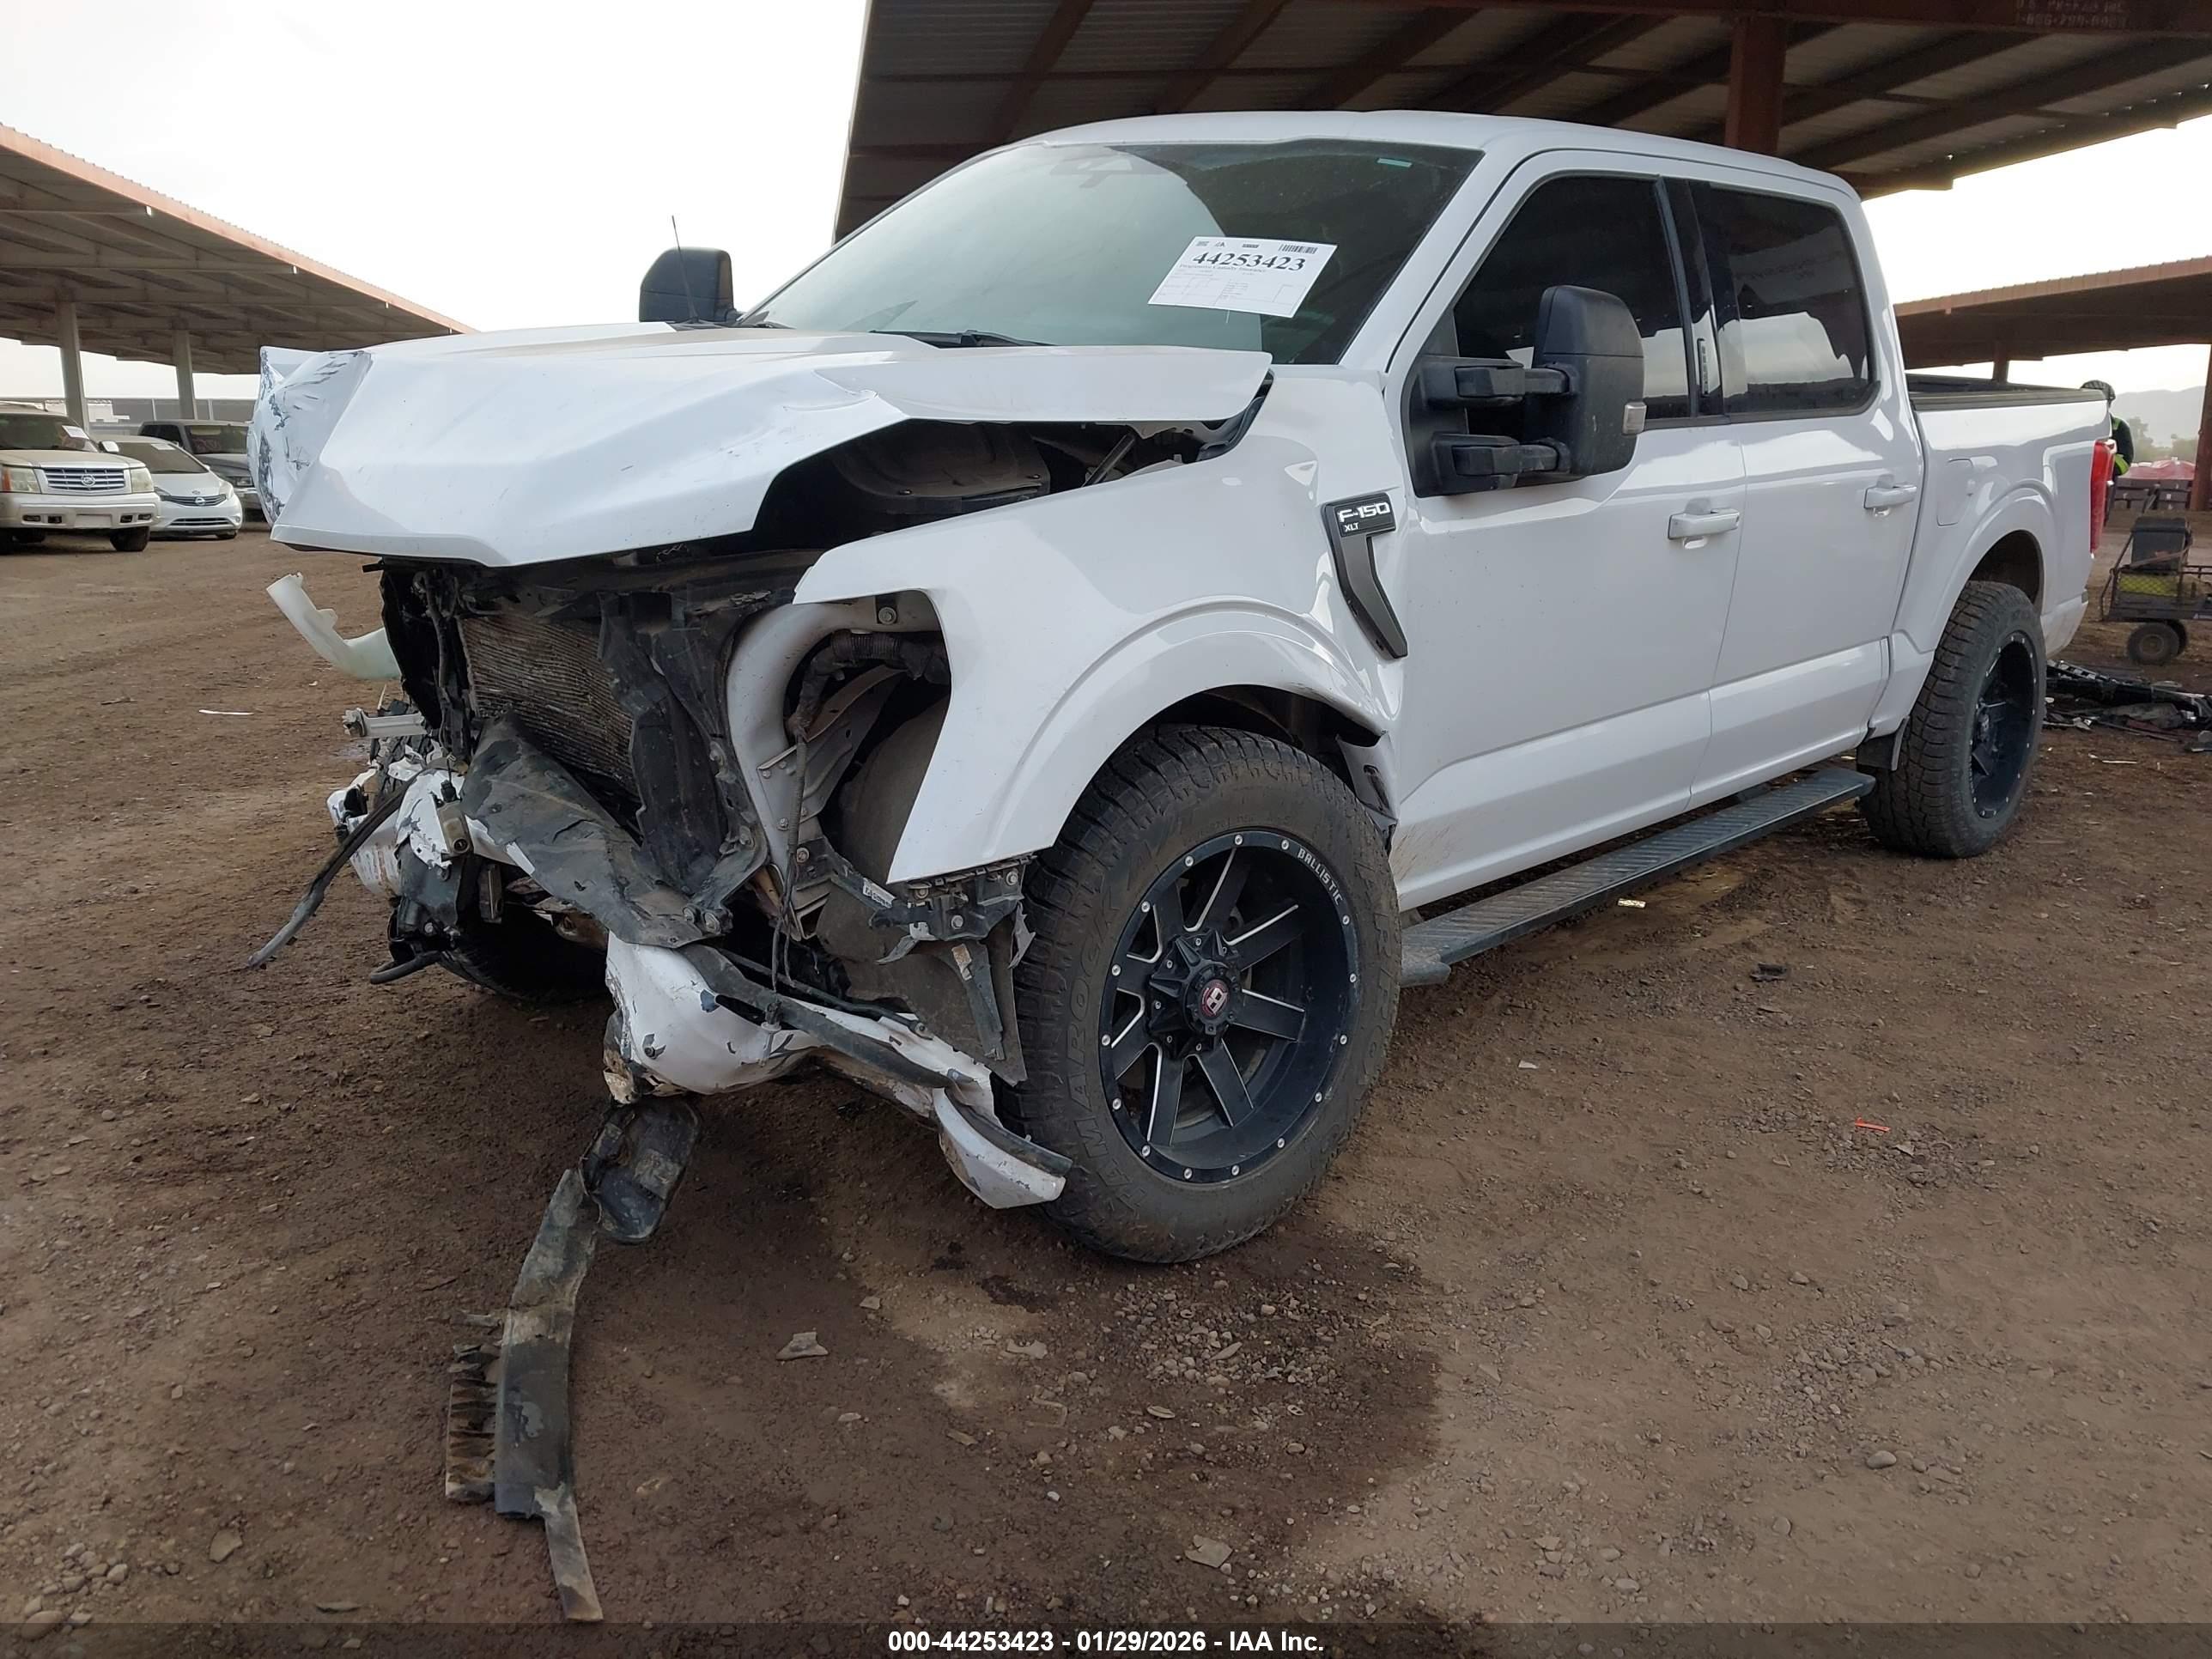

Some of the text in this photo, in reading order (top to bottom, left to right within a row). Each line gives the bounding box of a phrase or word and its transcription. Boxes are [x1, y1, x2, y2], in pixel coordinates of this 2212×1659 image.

[1193, 252, 1306, 271] 44253423
[1337, 502, 1390, 522] F-150
[1344, 522, 1359, 532] XLT
[1297, 848, 1343, 905] BALLISTIC
